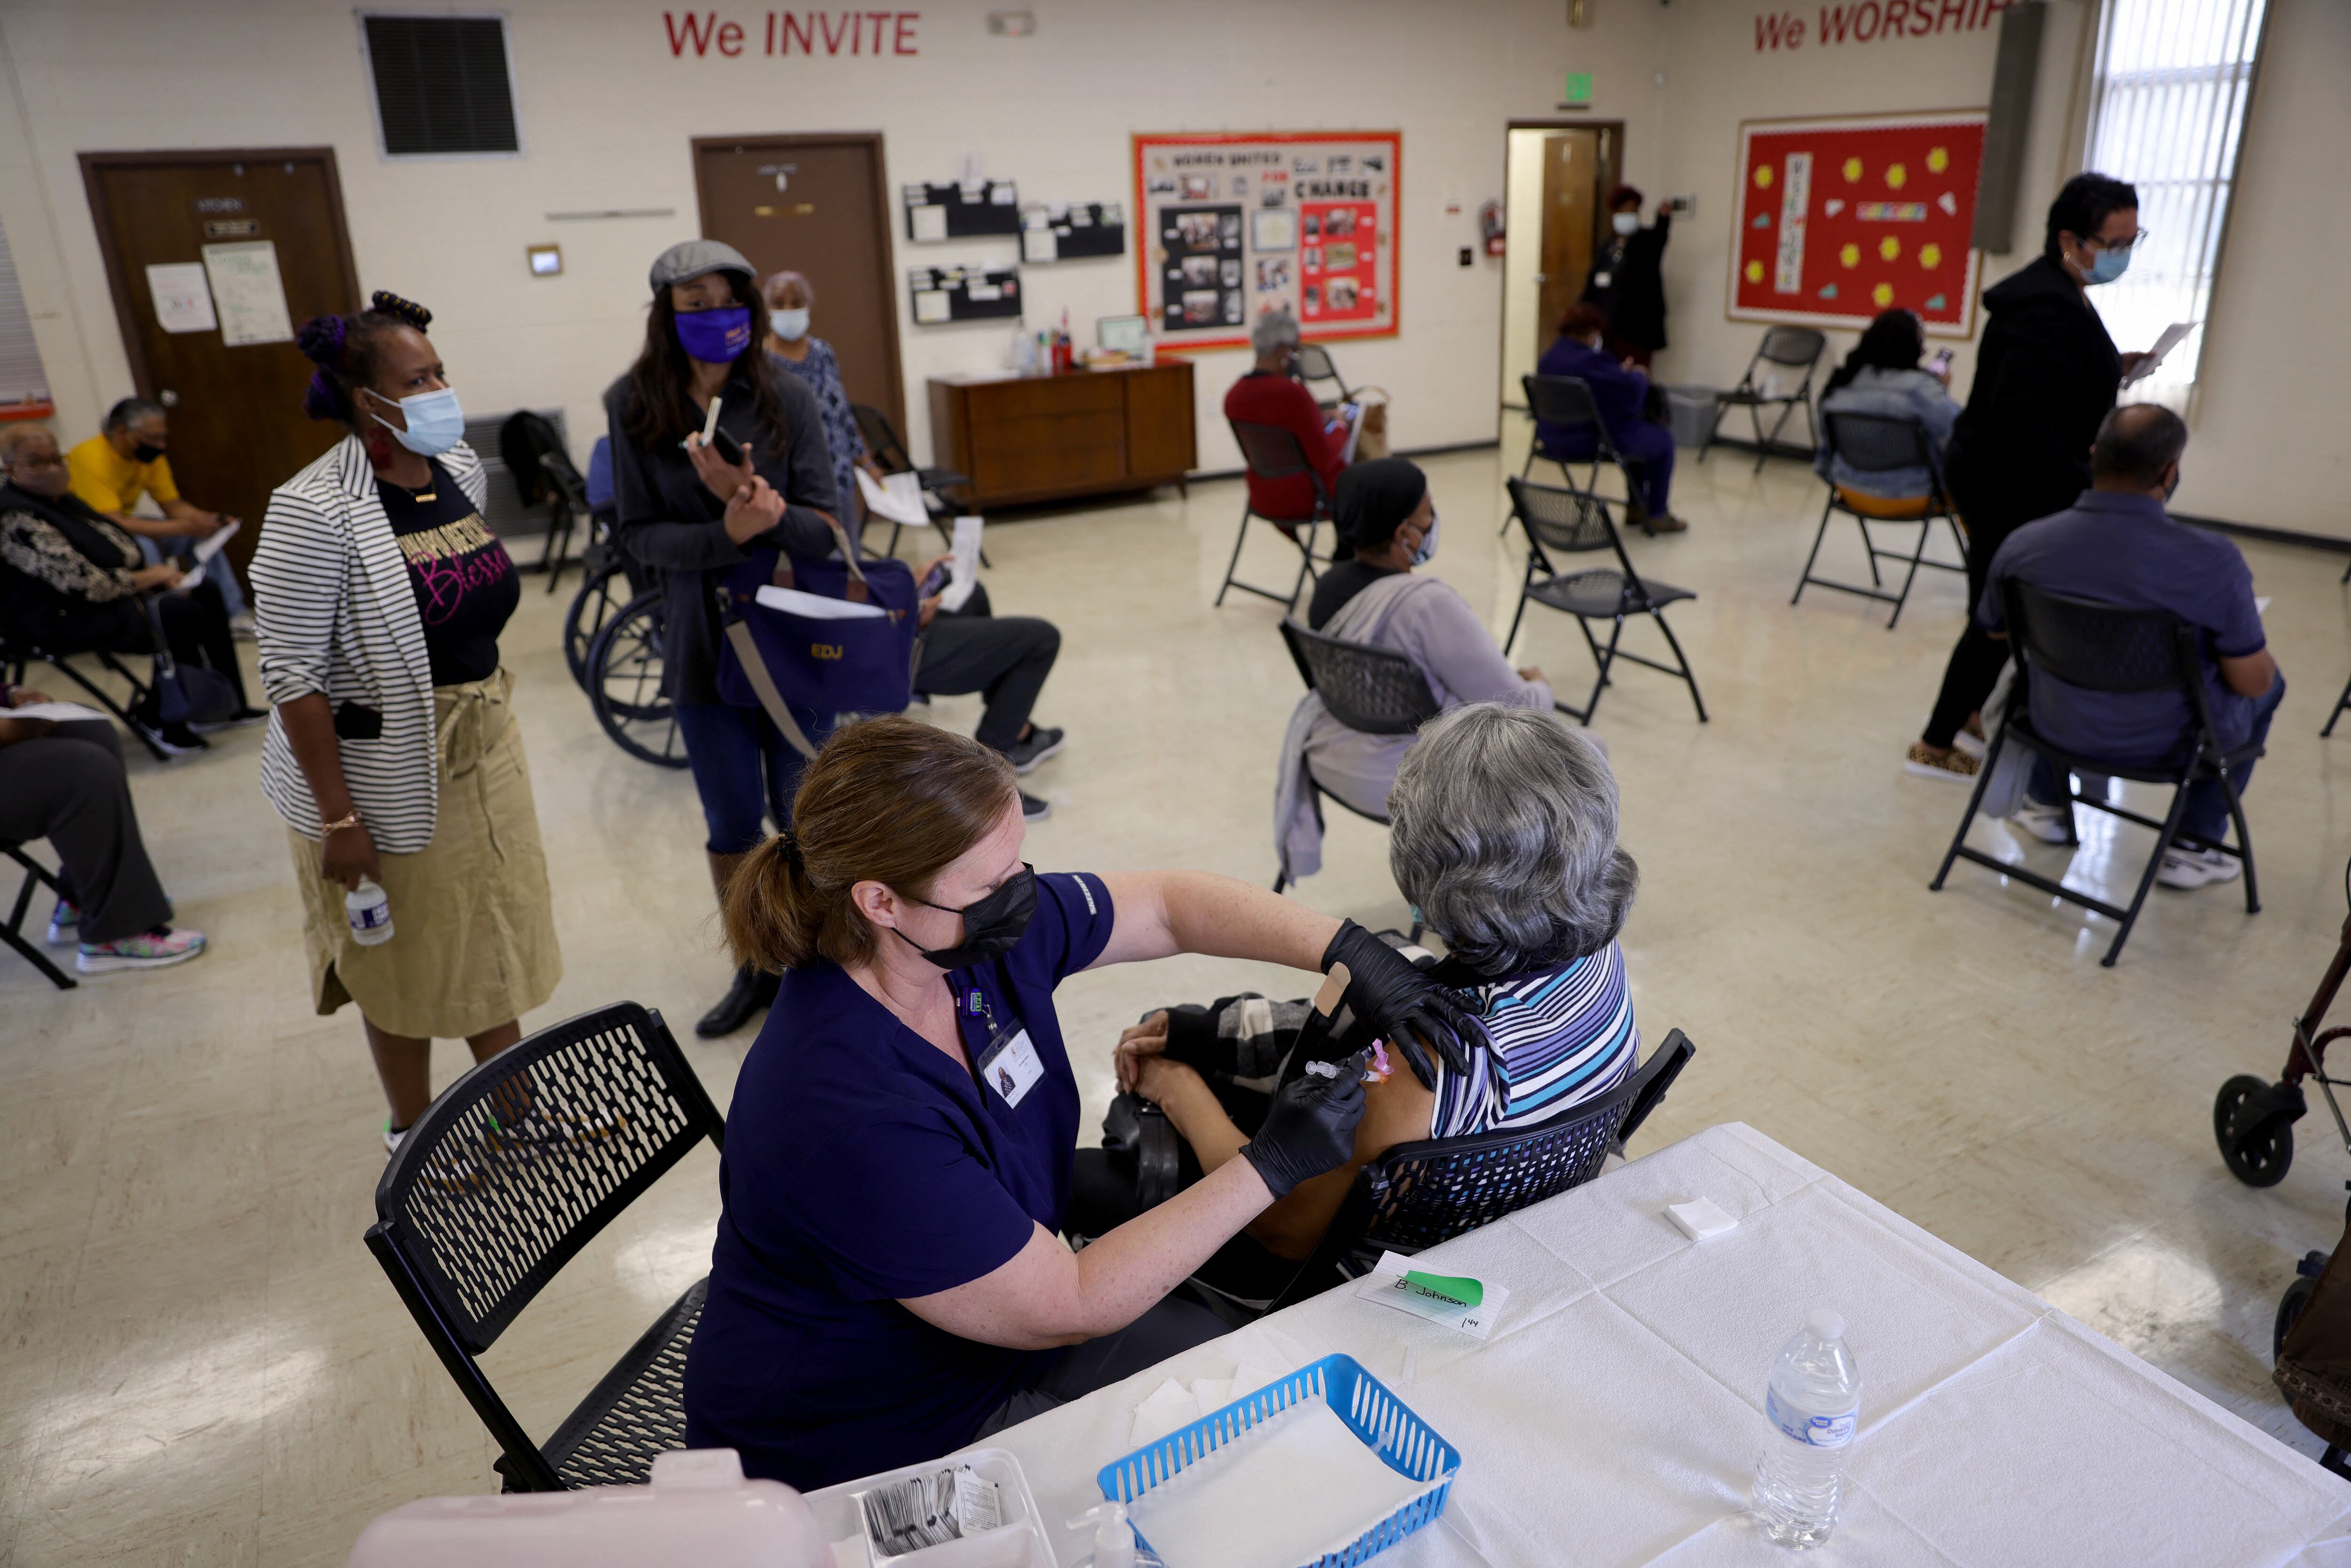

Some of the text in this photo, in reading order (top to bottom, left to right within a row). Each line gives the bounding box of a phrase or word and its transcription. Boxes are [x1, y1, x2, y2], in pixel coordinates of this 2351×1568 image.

[662, 12, 920, 56] We INVITE
[1755, 11, 1806, 52] We
[1295, 179, 1370, 198] CHANGE
[811, 643, 843, 660] EDJ
[1394, 1279, 1467, 1307] B. Johnson
